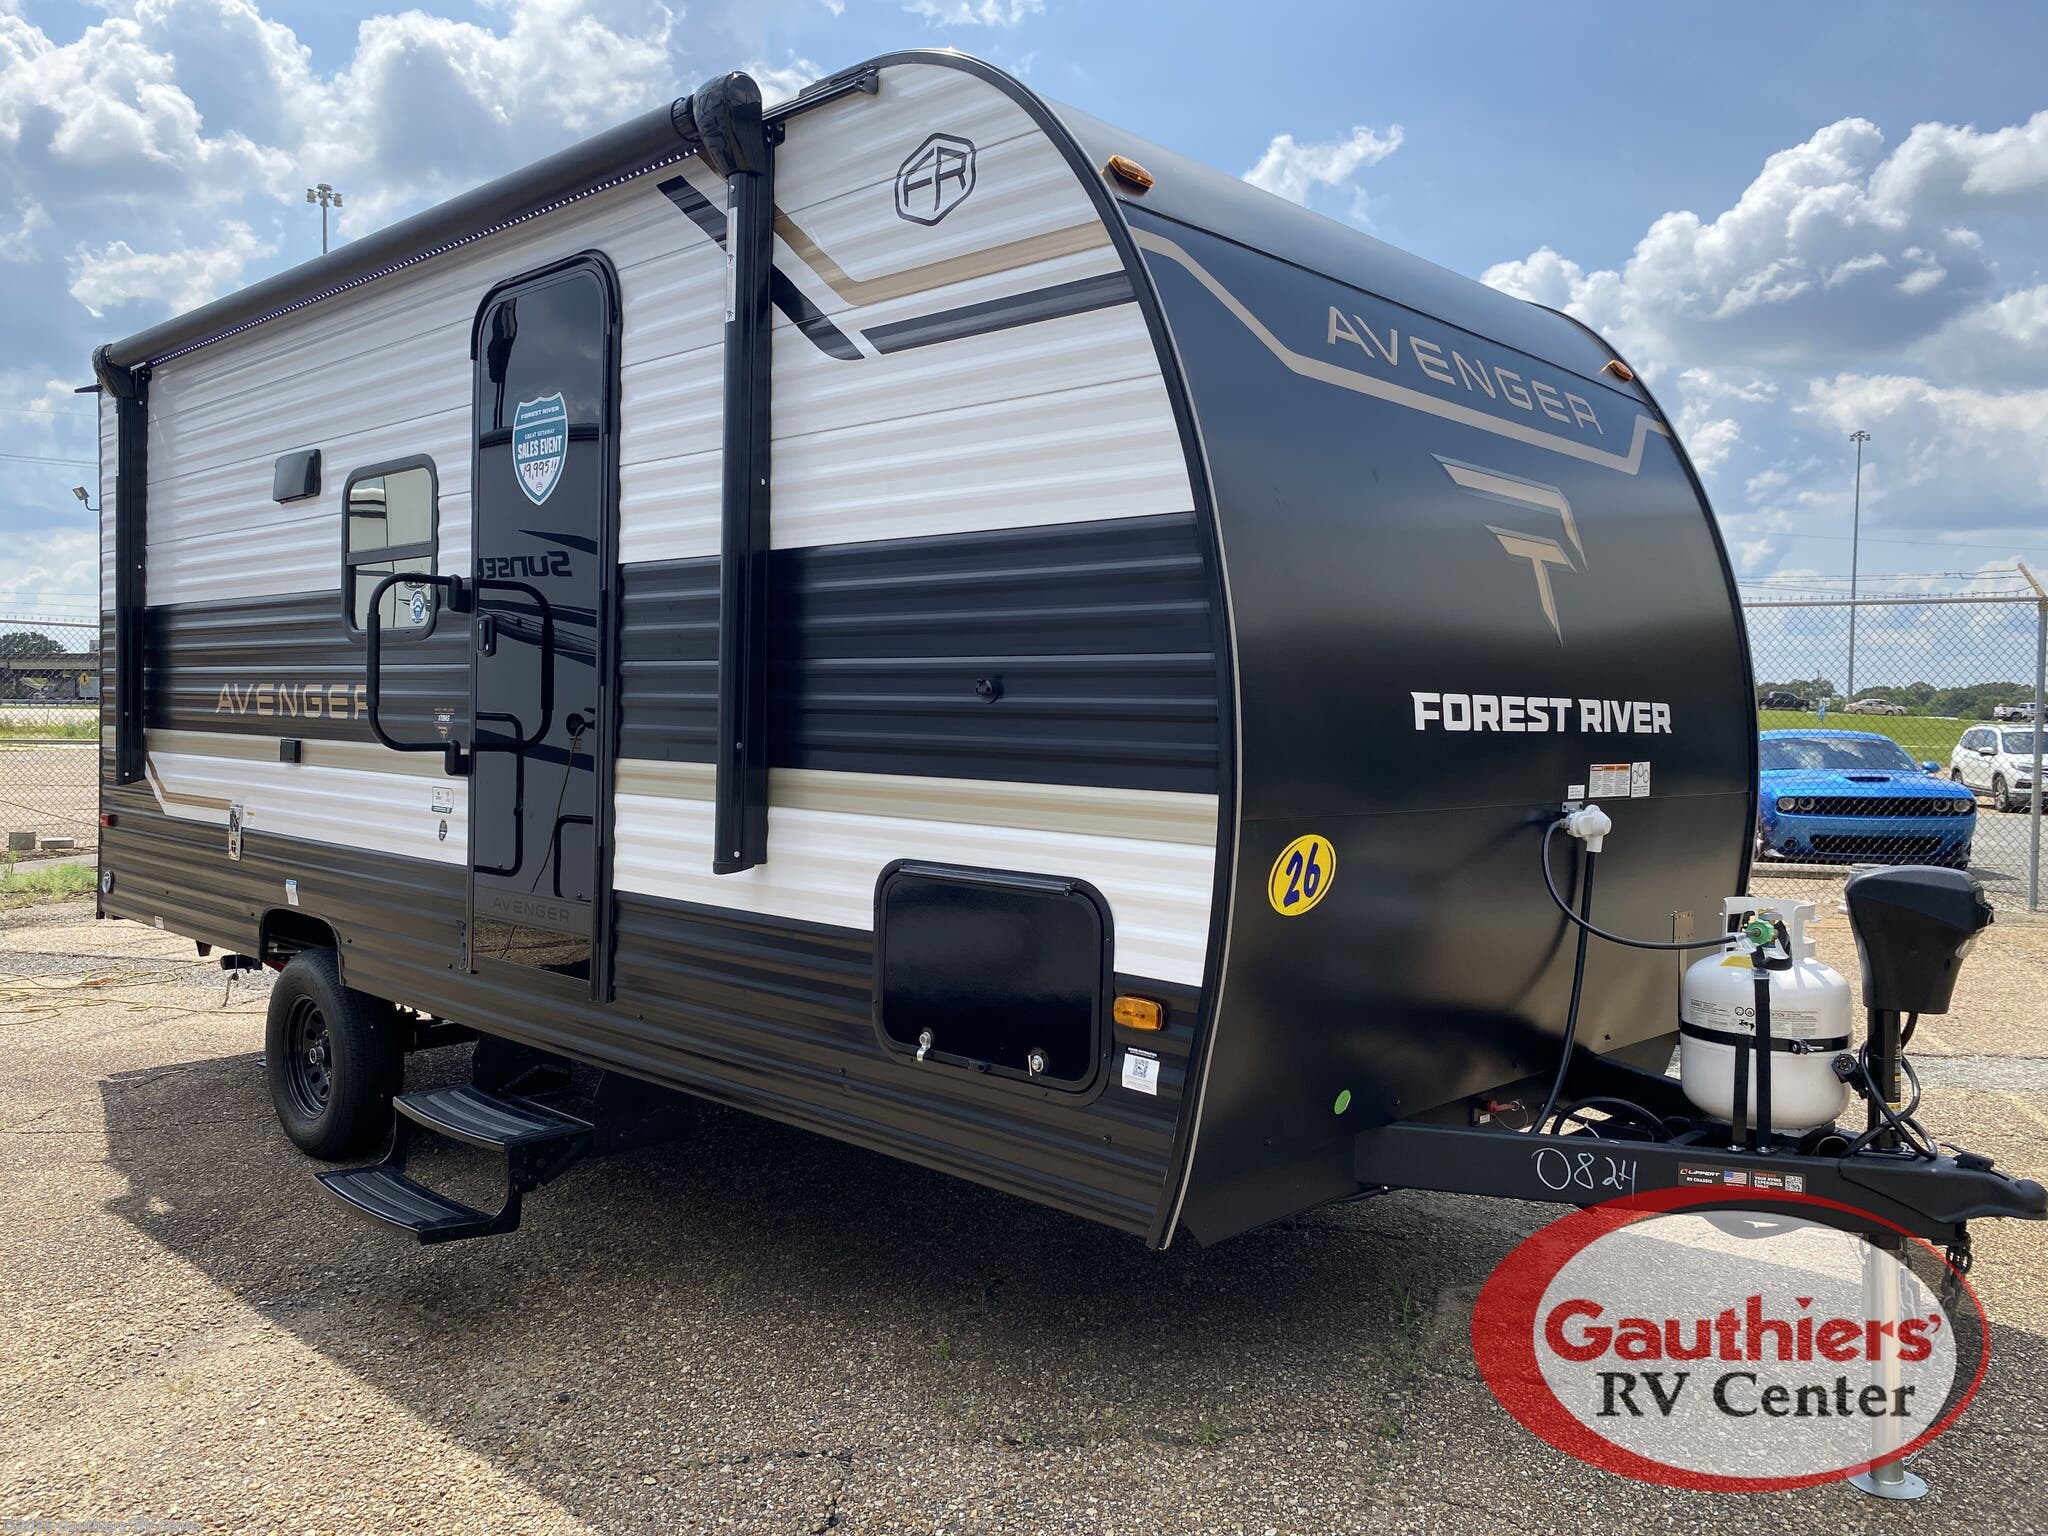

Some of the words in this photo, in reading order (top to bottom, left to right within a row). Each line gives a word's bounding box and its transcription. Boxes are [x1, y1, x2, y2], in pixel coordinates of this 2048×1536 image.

[1327, 305, 1604, 435] AVENGER
[521, 409, 542, 419] FOREST
[543, 406, 559, 414] RIVER
[517, 440, 539, 460] SALES
[540, 436, 562, 454] EVENT
[1410, 691, 1573, 733] FOREST
[1578, 698, 1673, 734] RIVER
[1283, 842, 1321, 908] 26
[492, 896, 570, 924] AVENGER
[1531, 1147, 1637, 1202] 0824
